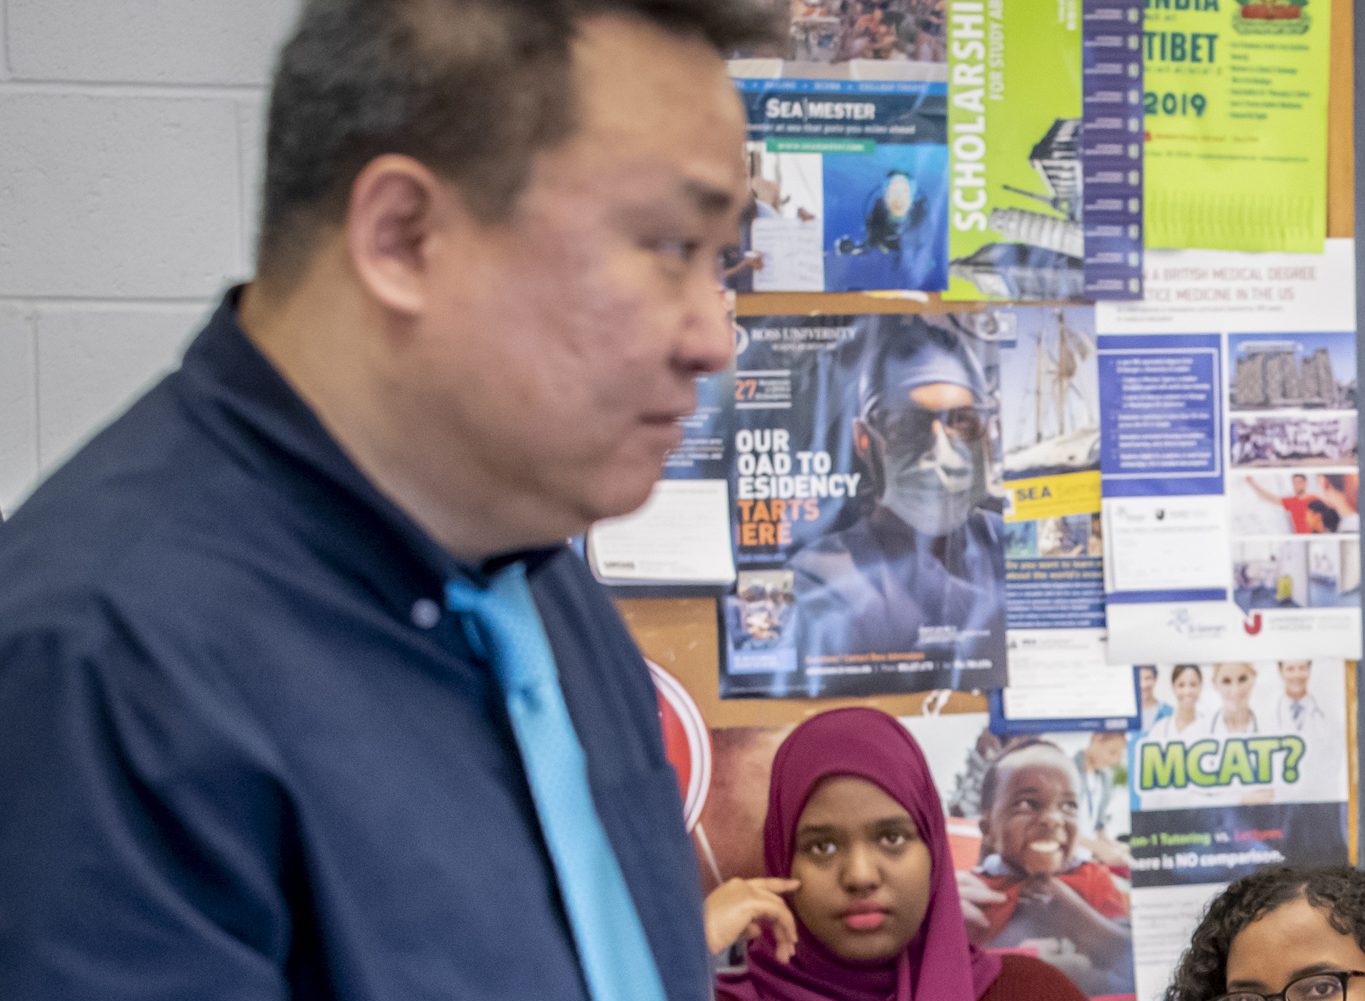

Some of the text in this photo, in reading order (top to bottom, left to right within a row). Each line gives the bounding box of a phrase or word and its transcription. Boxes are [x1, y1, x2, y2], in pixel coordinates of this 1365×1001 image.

[988, 22, 1005, 68] STUDY
[1143, 31, 1219, 63] TIBET
[988, 72, 1005, 100] FOR
[1144, 92, 1207, 117] 2019
[1212, 266, 1262, 281] MEDICAL
[1267, 266, 1316, 281] DEGREE
[1176, 288, 1231, 300] MEDICINE
[1252, 287, 1272, 300] THE
[796, 451, 832, 475] TO
[1140, 735, 1306, 790] MCAT?
[1175, 852, 1198, 869] NO
